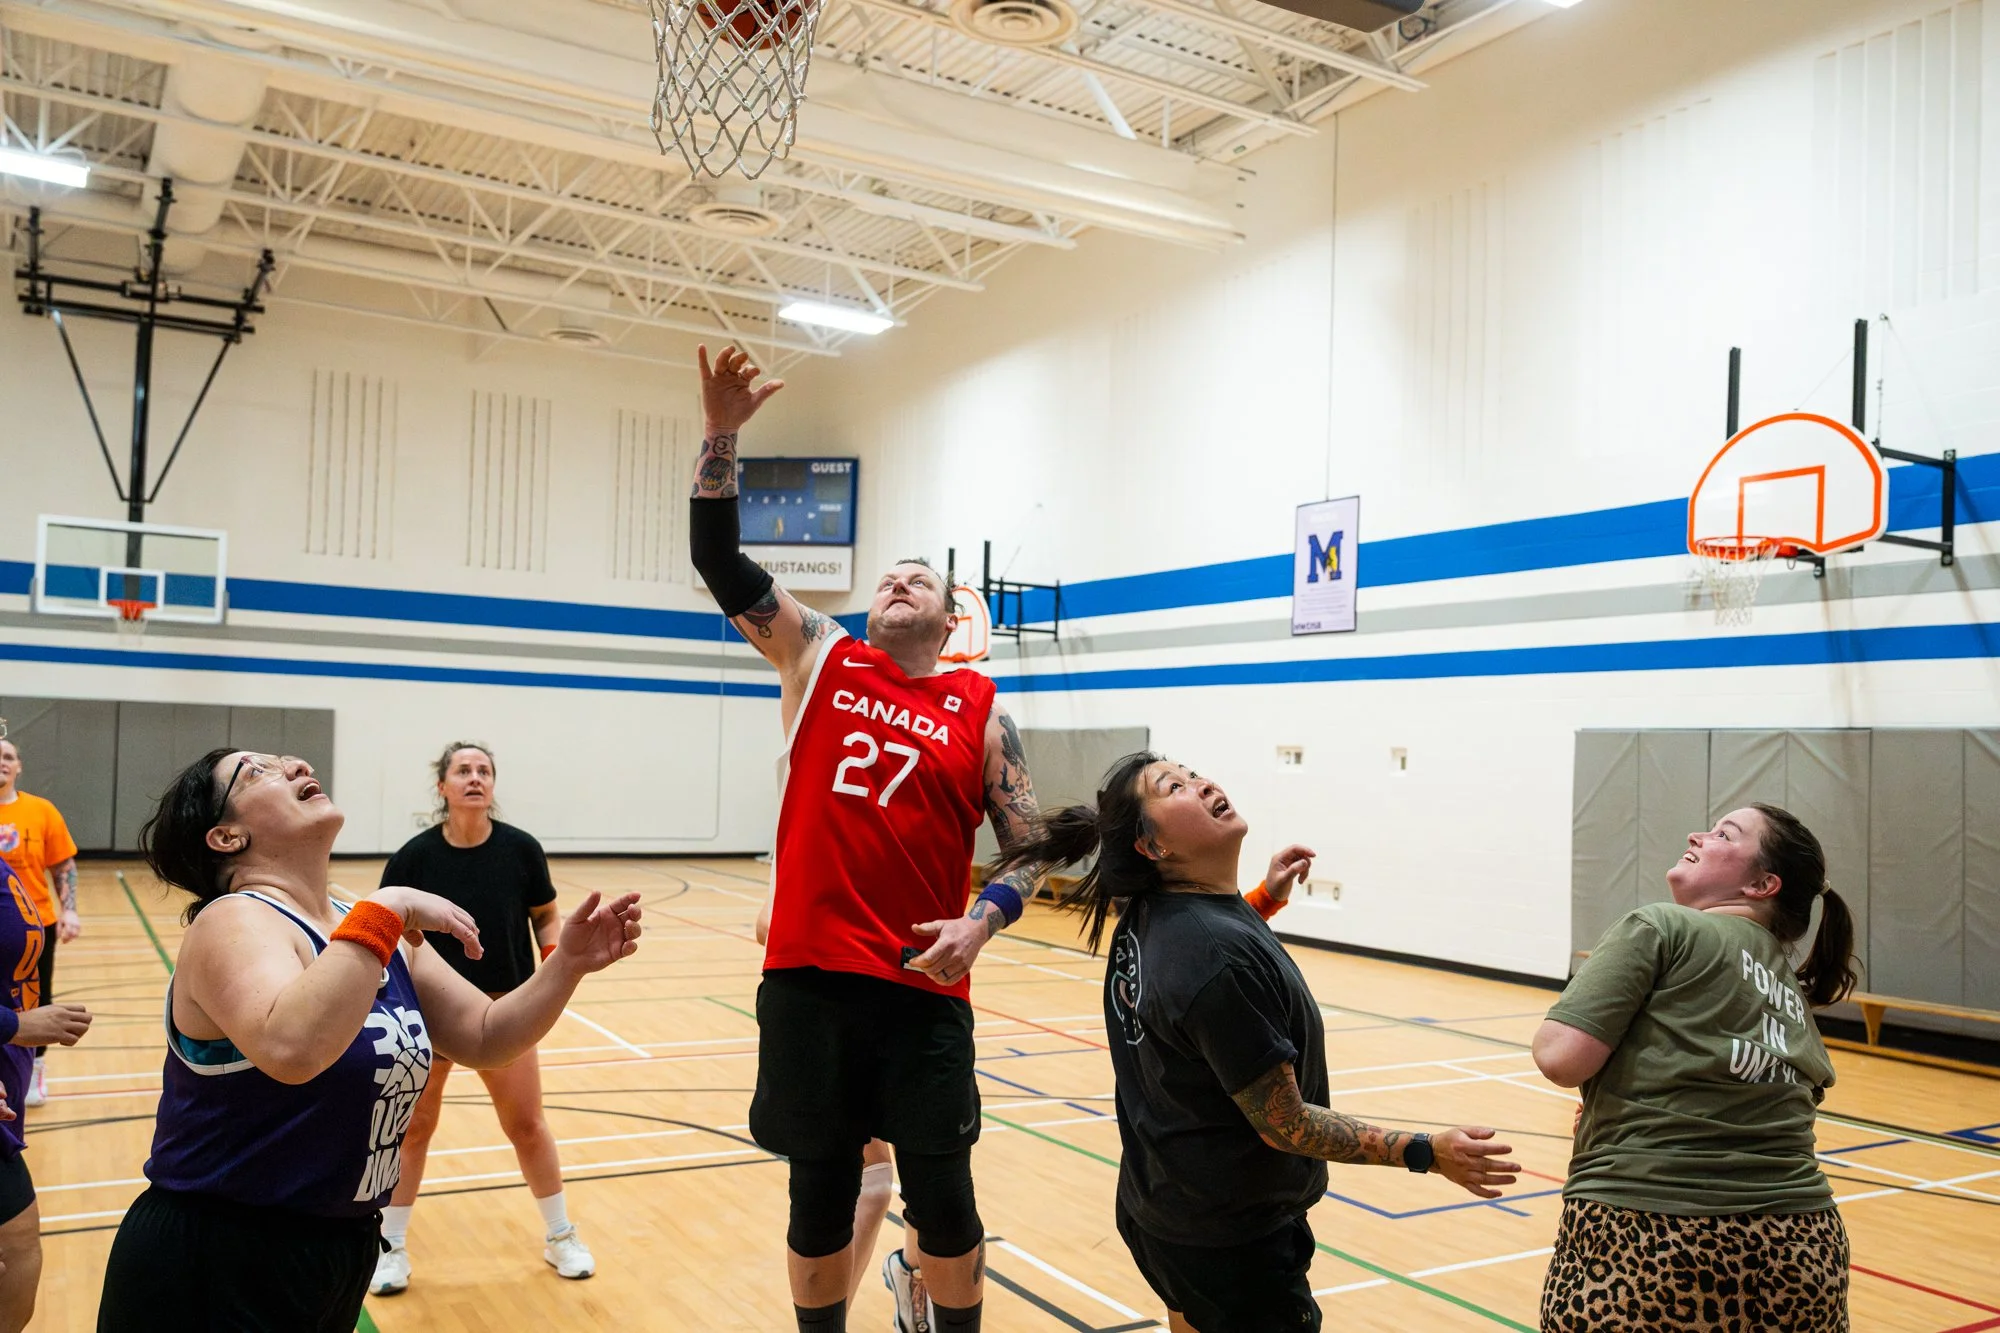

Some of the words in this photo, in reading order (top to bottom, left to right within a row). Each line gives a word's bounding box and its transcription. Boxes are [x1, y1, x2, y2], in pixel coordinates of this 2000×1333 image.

[811, 462, 852, 473] GUEST
[1307, 530, 1343, 583] M
[832, 689, 949, 746] CANADA
[832, 731, 920, 808] 27
[1742, 949, 1806, 1030] POWER
[1762, 1012, 1789, 1055] IN
